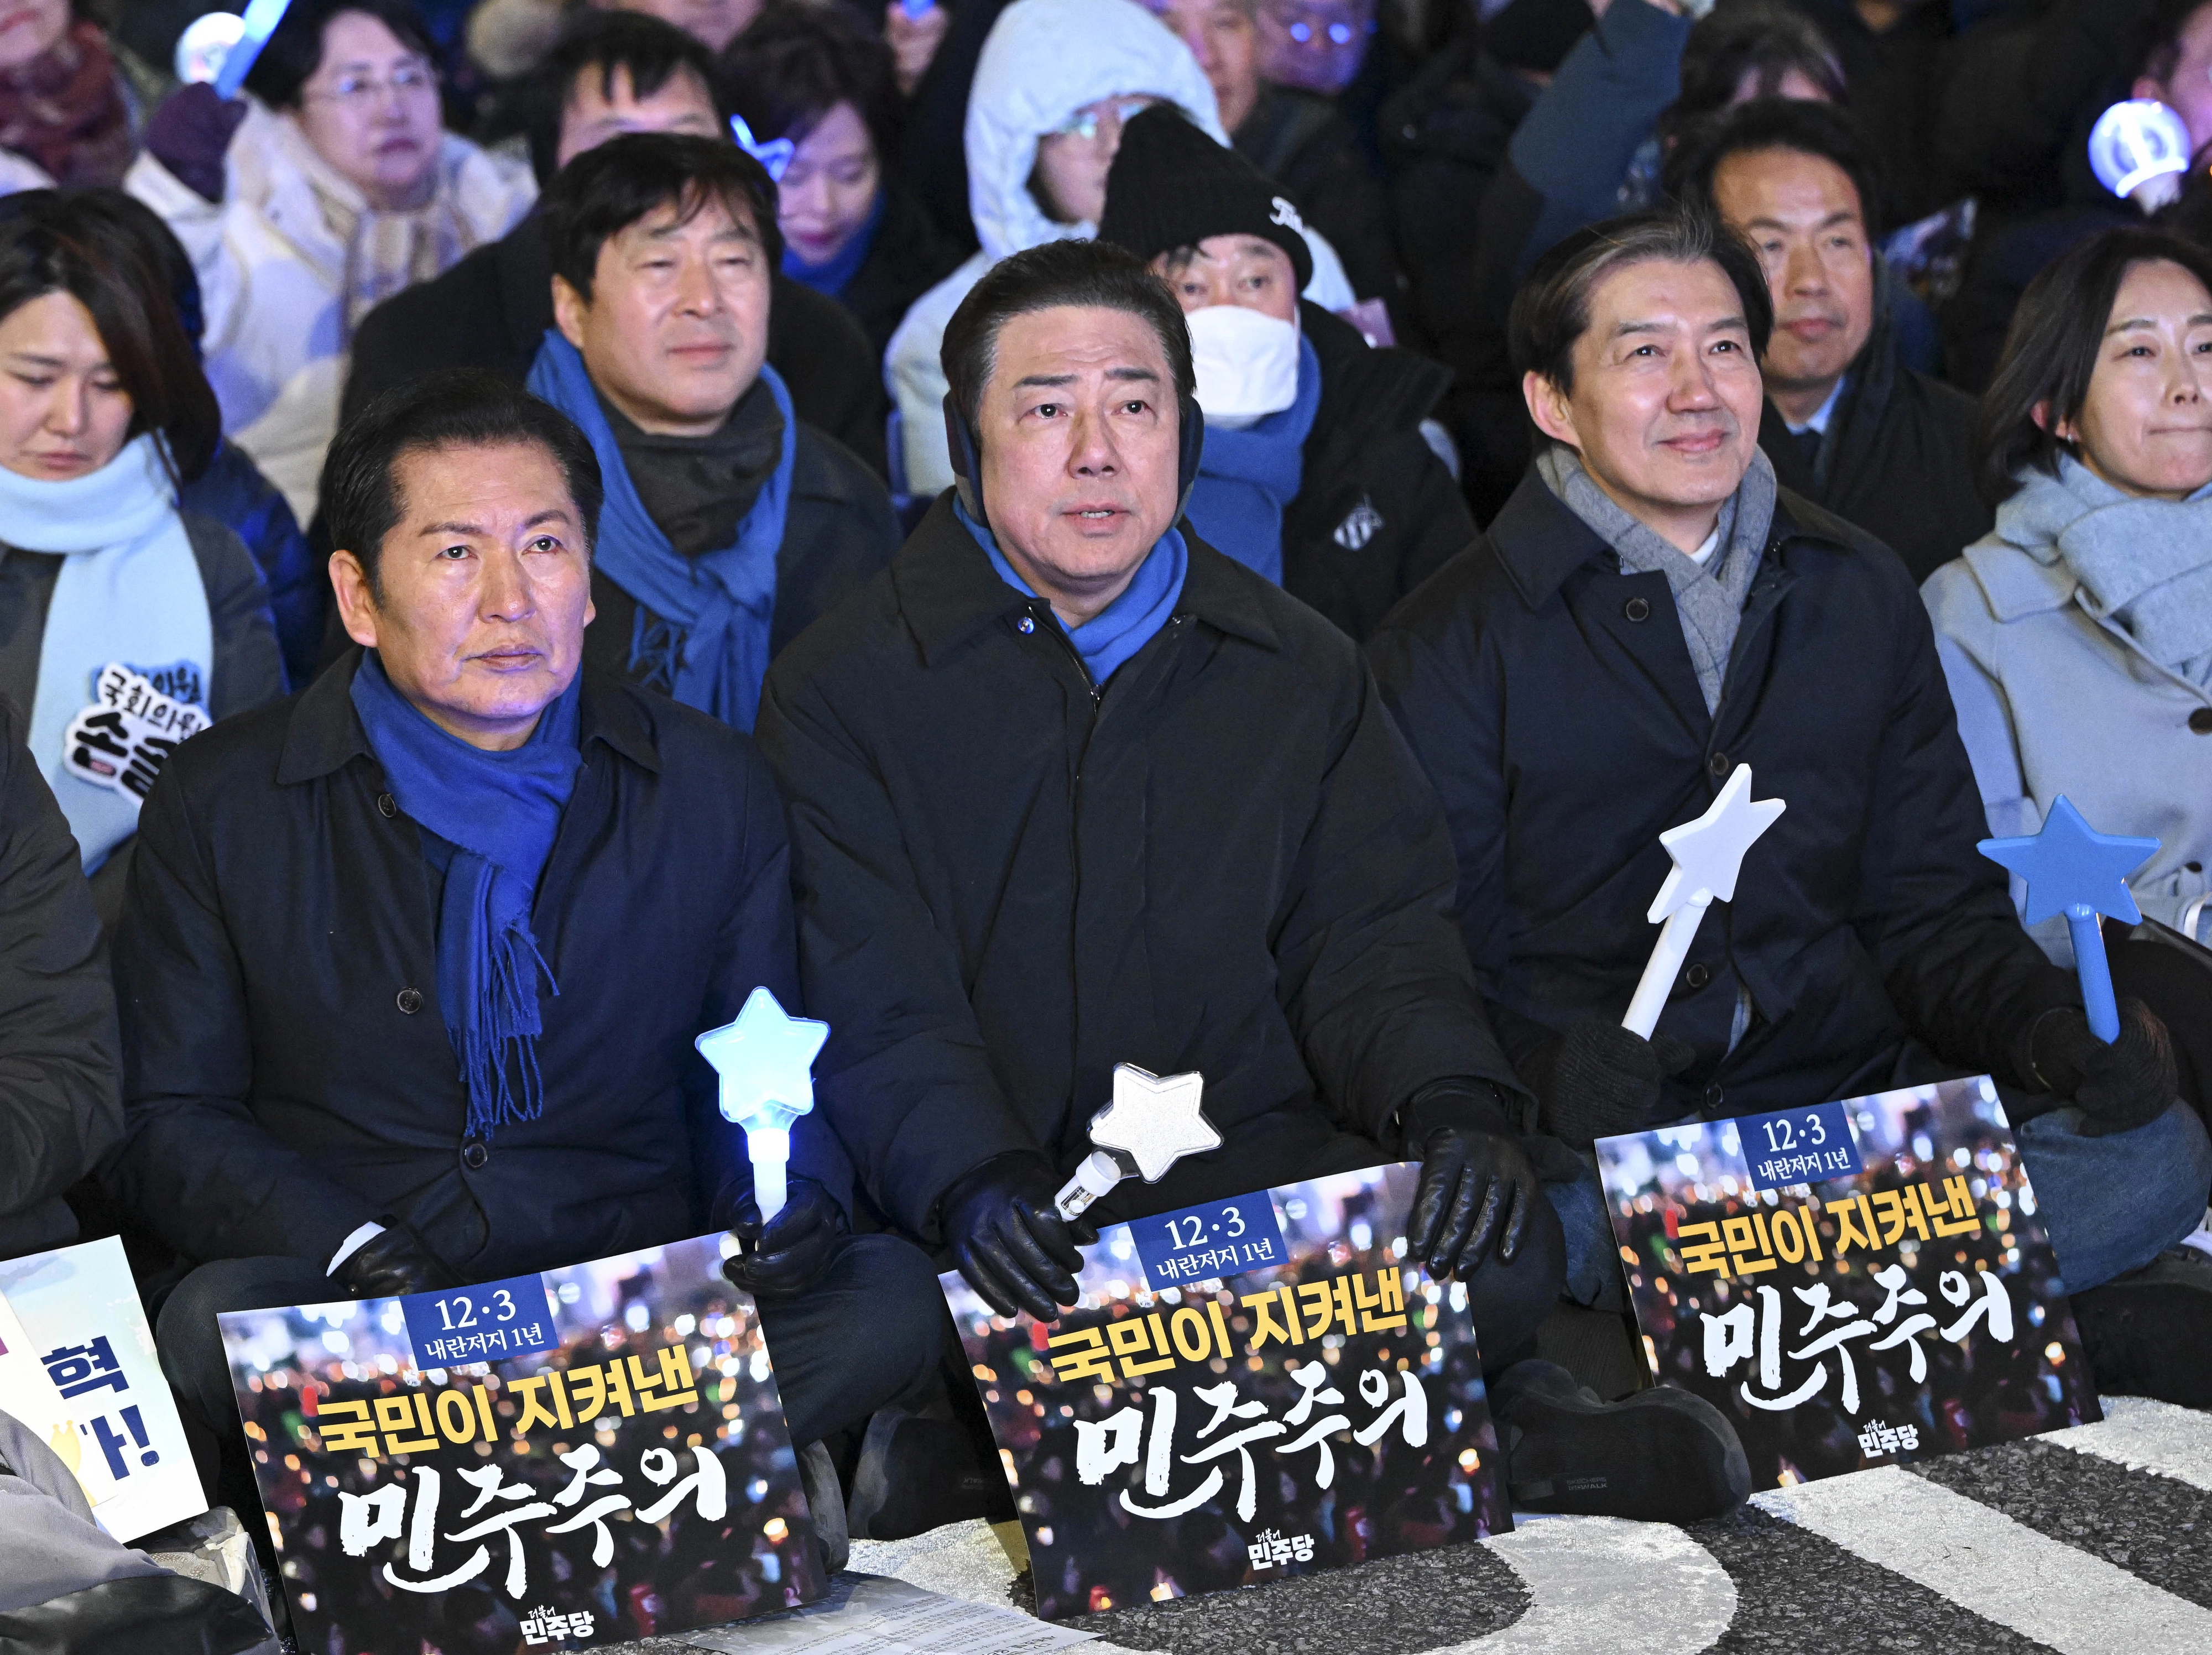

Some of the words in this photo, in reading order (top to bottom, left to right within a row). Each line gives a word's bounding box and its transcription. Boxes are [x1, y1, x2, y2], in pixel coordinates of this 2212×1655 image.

[1758, 1152, 1822, 1181] 내란저지
[1824, 1147, 1850, 1169] 1년
[1677, 1205, 1823, 1278] 국민이
[1826, 1176, 1981, 1254] 지켜낸
[1156, 1246, 1238, 1278] 내란저지
[1243, 1238, 1275, 1261] 1년
[425, 1330, 507, 1360] 내란저지
[511, 1323, 544, 1346] 1년
[1047, 1301, 1233, 1381] 국민이
[1241, 1267, 1407, 1350] 지켜낸
[1699, 1264, 2013, 1414] 민주주의
[40, 1335, 129, 1400] 혁
[317, 1385, 498, 1458] 국민이
[507, 1345, 698, 1434] 지켜낸
[1074, 1359, 1428, 1522] 민주주의
[1858, 1424, 1919, 1458] 민주당
[1863, 1418, 1887, 1433] 더불어
[338, 1443, 727, 1599] 민주주의
[1255, 1528, 1281, 1543] 더불어
[1248, 1534, 1314, 1570] 민주당
[520, 1611, 594, 1645] 민주당
[528, 1605, 556, 1619] 더불어
